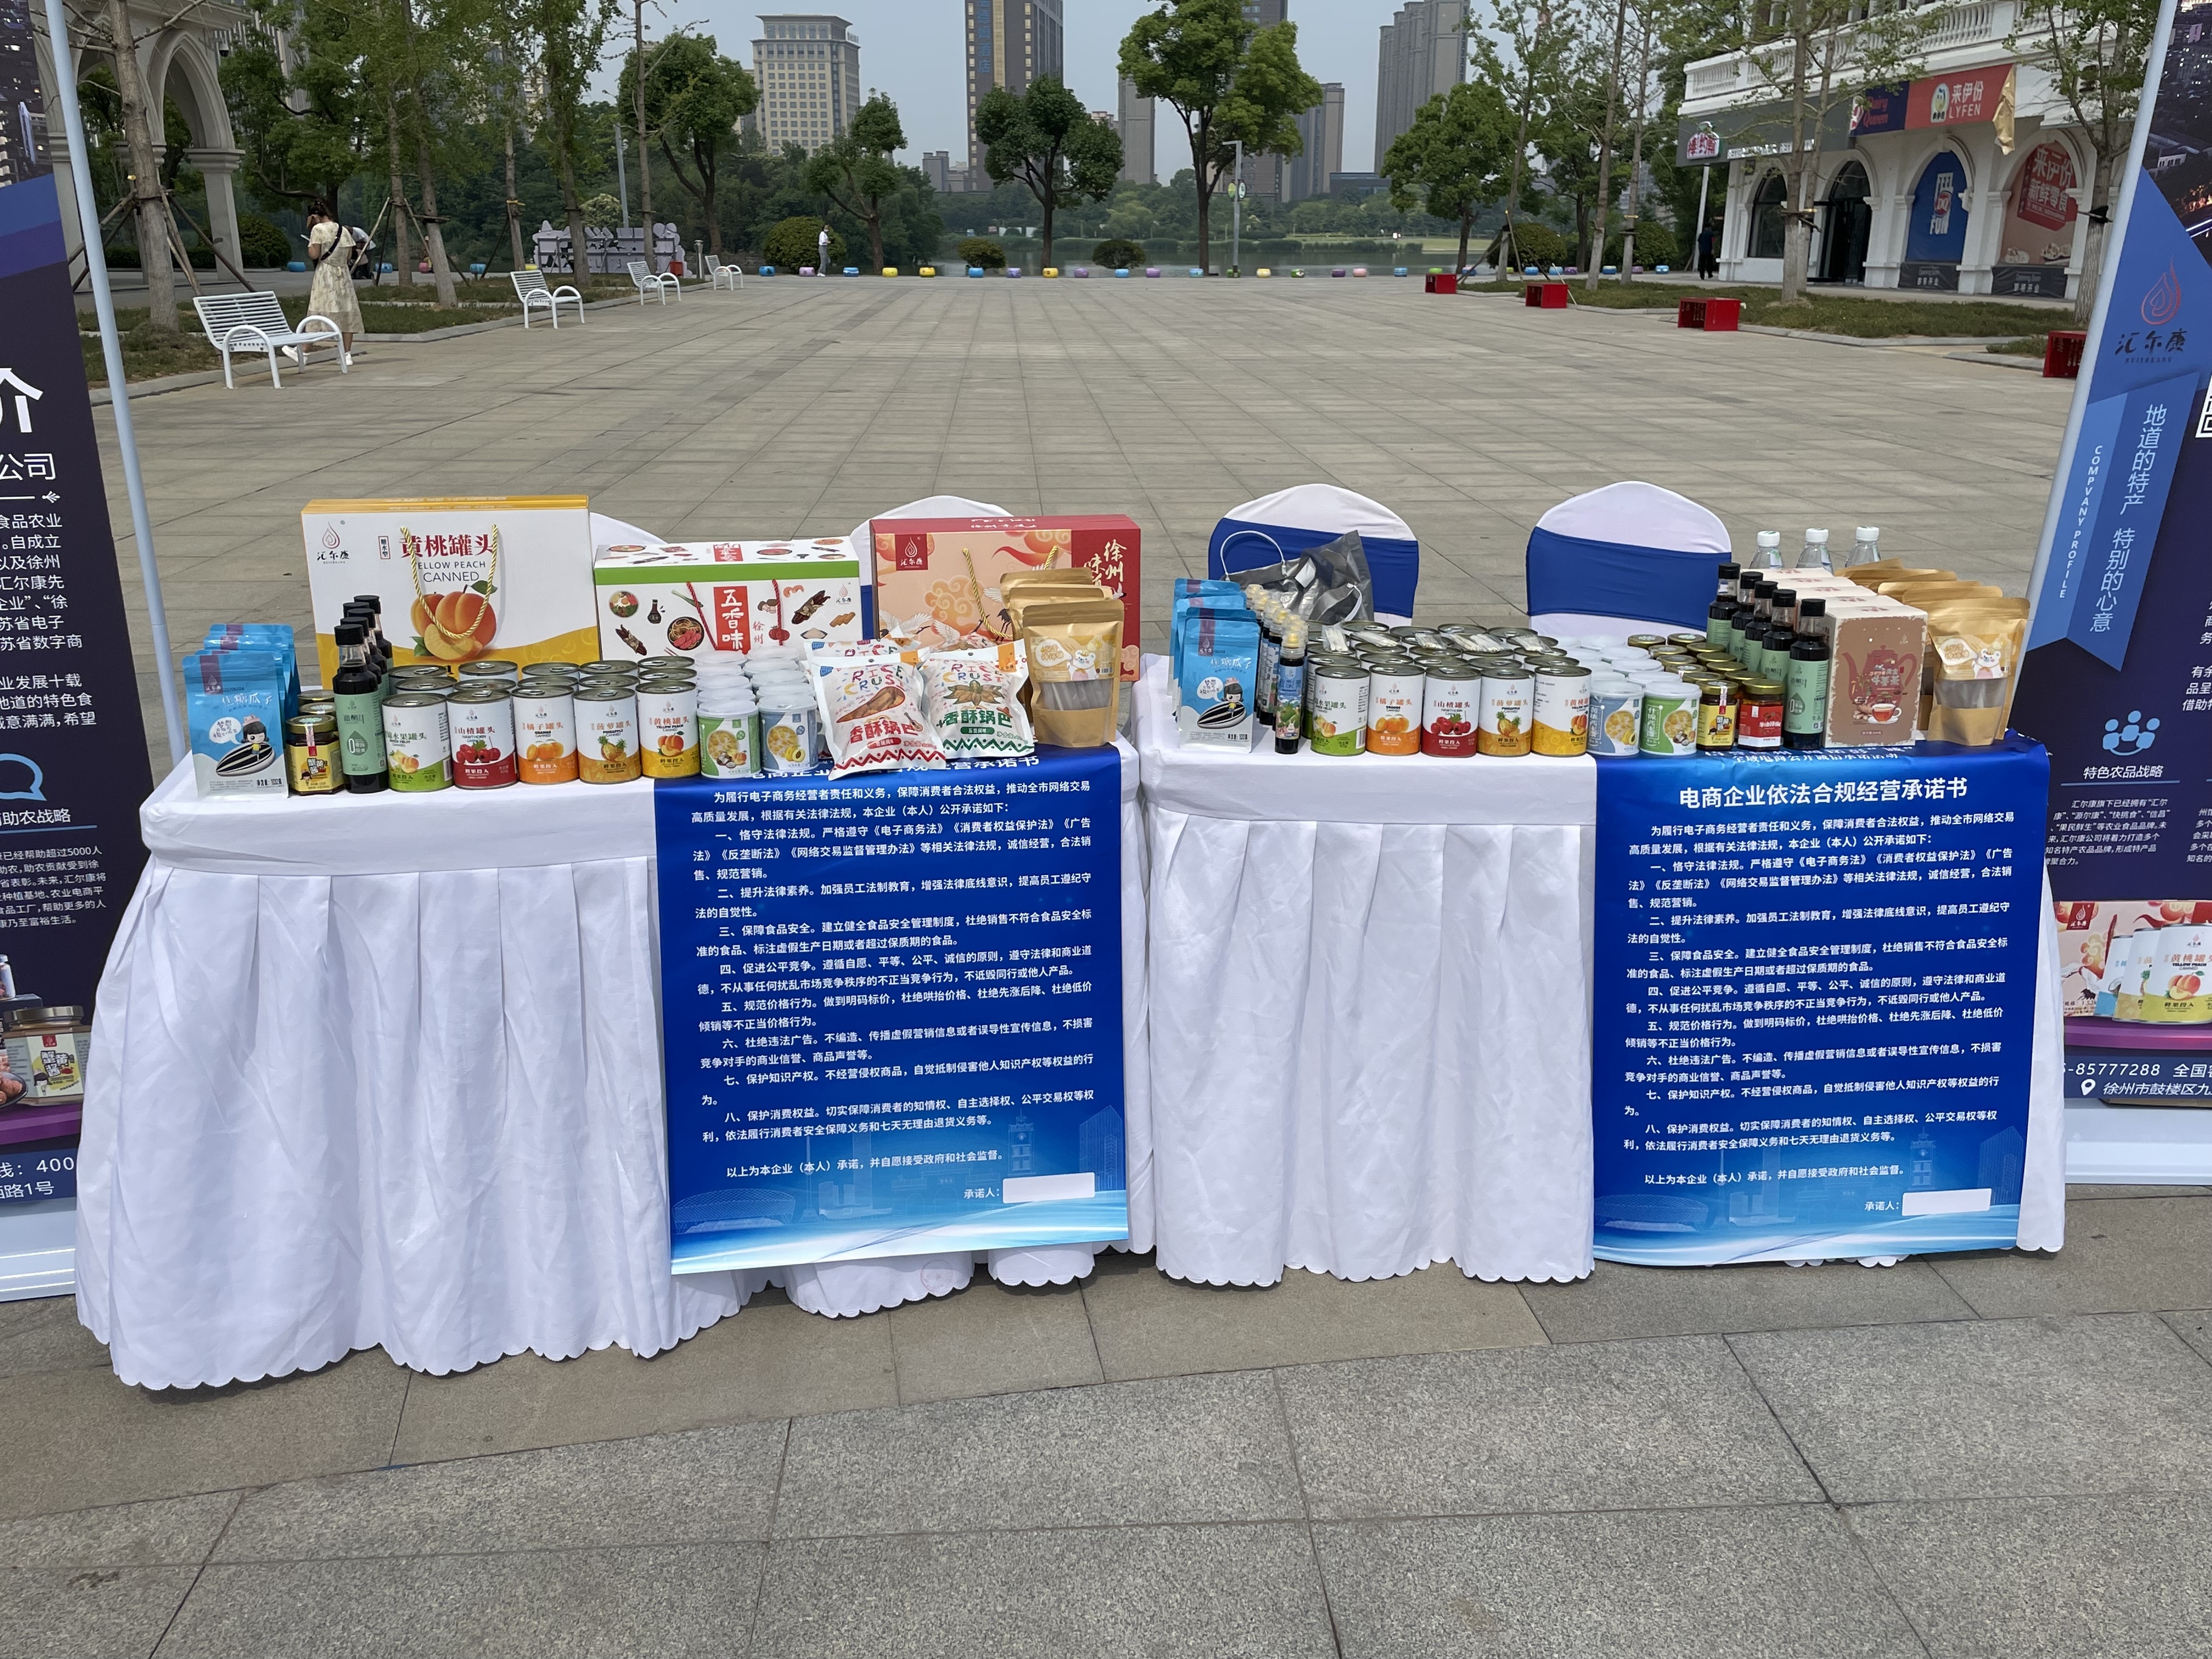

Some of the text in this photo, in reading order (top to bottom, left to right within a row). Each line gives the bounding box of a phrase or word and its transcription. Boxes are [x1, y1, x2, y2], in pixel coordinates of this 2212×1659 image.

[1951, 81, 1984, 104] 来伊份
[1949, 104, 1980, 119] LYFEN
[2115, 328, 2187, 356] 汇尔康
[0, 453, 56, 481] 公司
[0, 513, 63, 529] 食品农业
[2059, 445, 2103, 599] COMPVANY PROFILE
[2090, 404, 2168, 633] 地道的特产 特别的心意
[399, 534, 494, 559] 黄桃罐头
[0, 554, 61, 570] 以及徐州
[317, 549, 350, 561] 汇尔康
[1103, 539, 1127, 582] 徐州
[416, 560, 486, 570] ELLOW PEACH
[423, 571, 479, 583] CANNED
[0, 615, 64, 631] 苏省电子
[721, 590, 744, 651] 五香味
[752, 620, 765, 645] 徐州
[0, 634, 83, 651] 苏省数字商
[852, 664, 904, 683] RICE
[942, 672, 1005, 683] CRUST
[0, 673, 82, 691] 业发展十载
[653, 716, 690, 725] 黄桃罐头
[944, 709, 1013, 728] 香酥锅巴
[850, 719, 918, 744] 香酥锅巴
[2083, 765, 2163, 780] 特色农品战略
[1680, 777, 1967, 809] 电商企业依法合规经营承诺书
[0, 808, 71, 827] 助农战略
[693, 868, 768, 881] 售、规范营销。
[1628, 897, 1697, 909] 售、规范营销。
[695, 906, 757, 919] 法的自觉性。
[1628, 933, 1686, 944] 法的自觉性。
[699, 1016, 817, 1032] 倾销等不正当价格行为。
[1626, 1037, 1736, 1048] 倾销等不正当价格行为。
[700, 1049, 872, 1069] 竞争对手的商业信誉、商品声誉等。
[1625, 1069, 1786, 1083] 竞争对手的商业信誉、商品声誉等。
[702, 1095, 718, 1106] 为。
[1624, 1106, 1639, 1116] 为。
[36, 1157, 75, 1173] 400
[963, 1187, 1000, 1200] 承诺人：
[1864, 1200, 1901, 1212] 承诺人：
